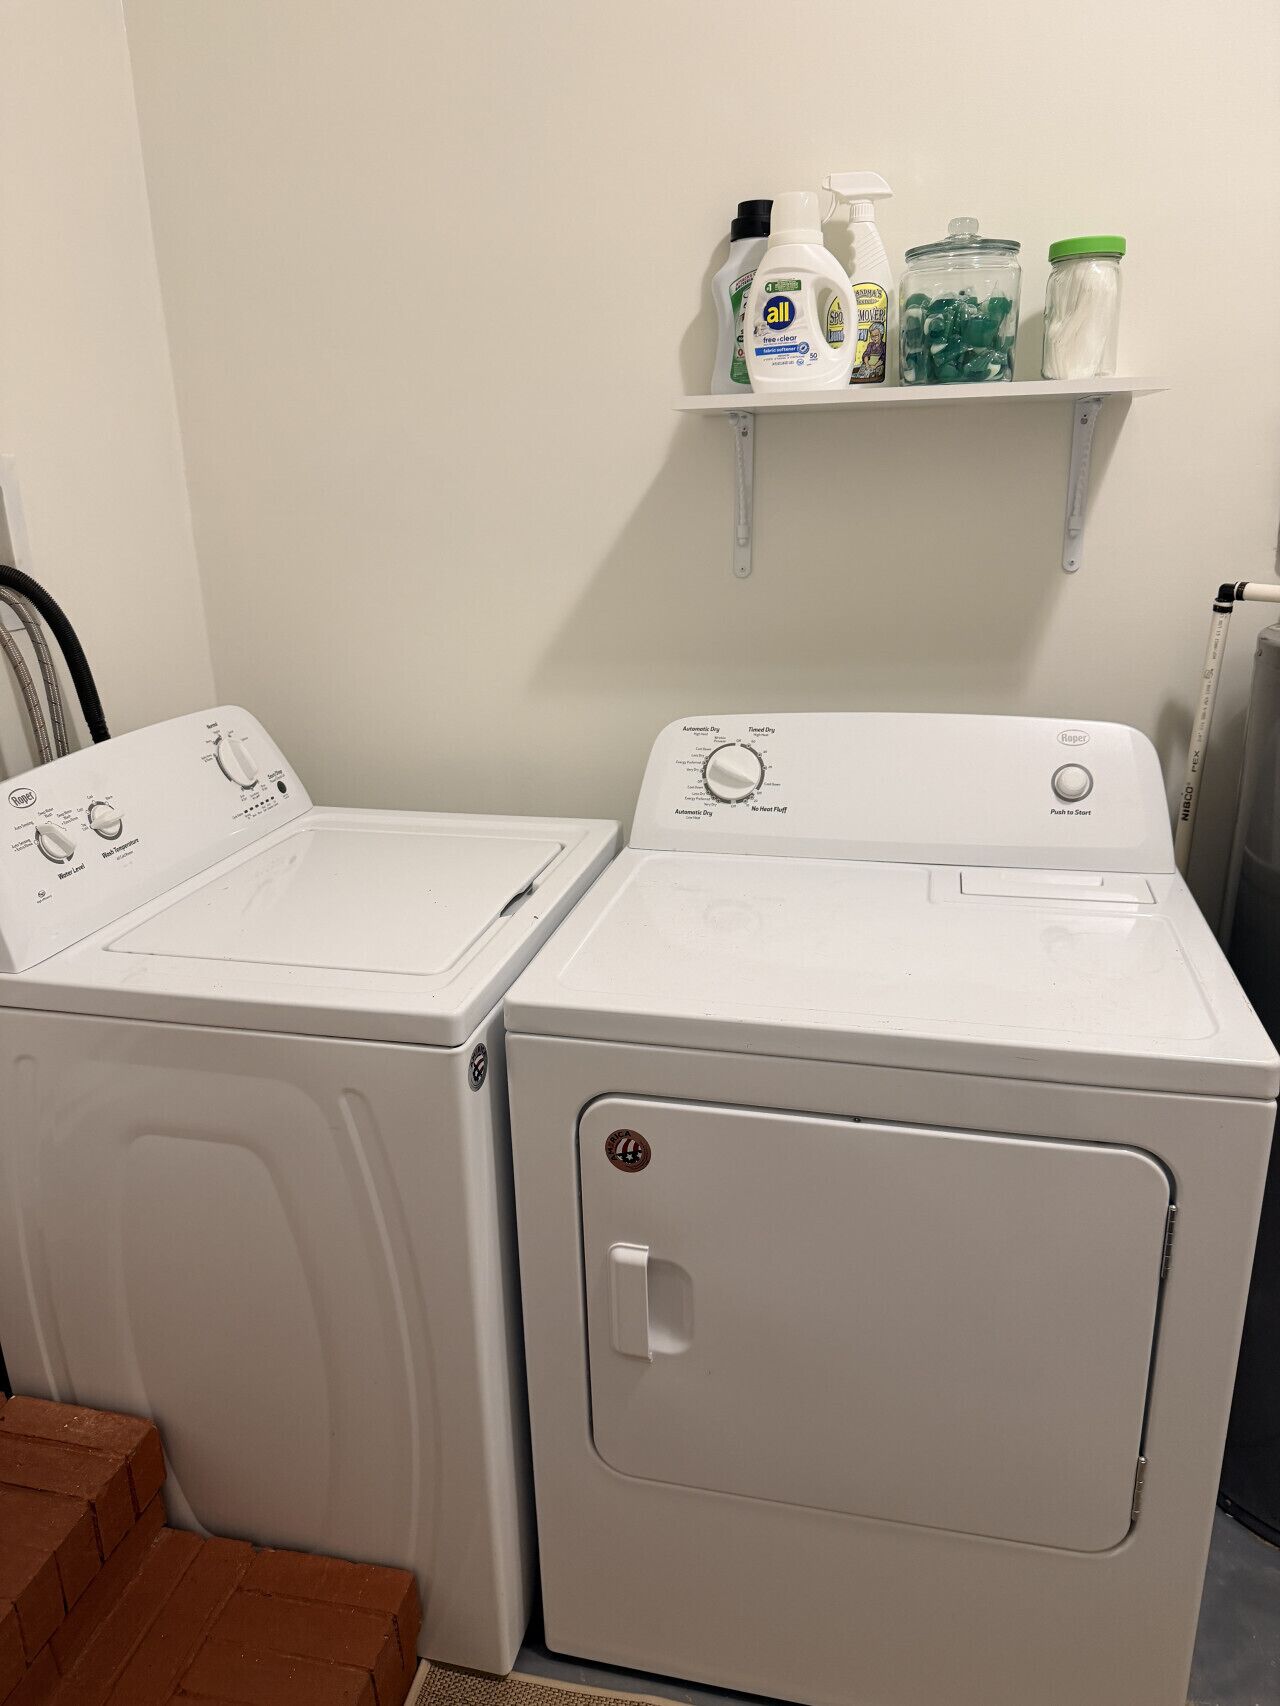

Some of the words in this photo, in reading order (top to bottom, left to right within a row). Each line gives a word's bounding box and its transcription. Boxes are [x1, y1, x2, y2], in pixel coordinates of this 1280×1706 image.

[855, 288, 883, 299] ANDMA'S
[767, 301, 789, 323] all
[830, 310, 844, 325] SPO
[857, 308, 885, 323] MOVER
[1061, 733, 1087, 744] Roper
[11, 792, 34, 806] Roper
[1181, 786, 1194, 822] NIBCO
[102, 849, 114, 859] Wash
[113, 838, 139, 852] Temperature
[58, 870, 73, 880] Water
[72, 863, 86, 874] Level
